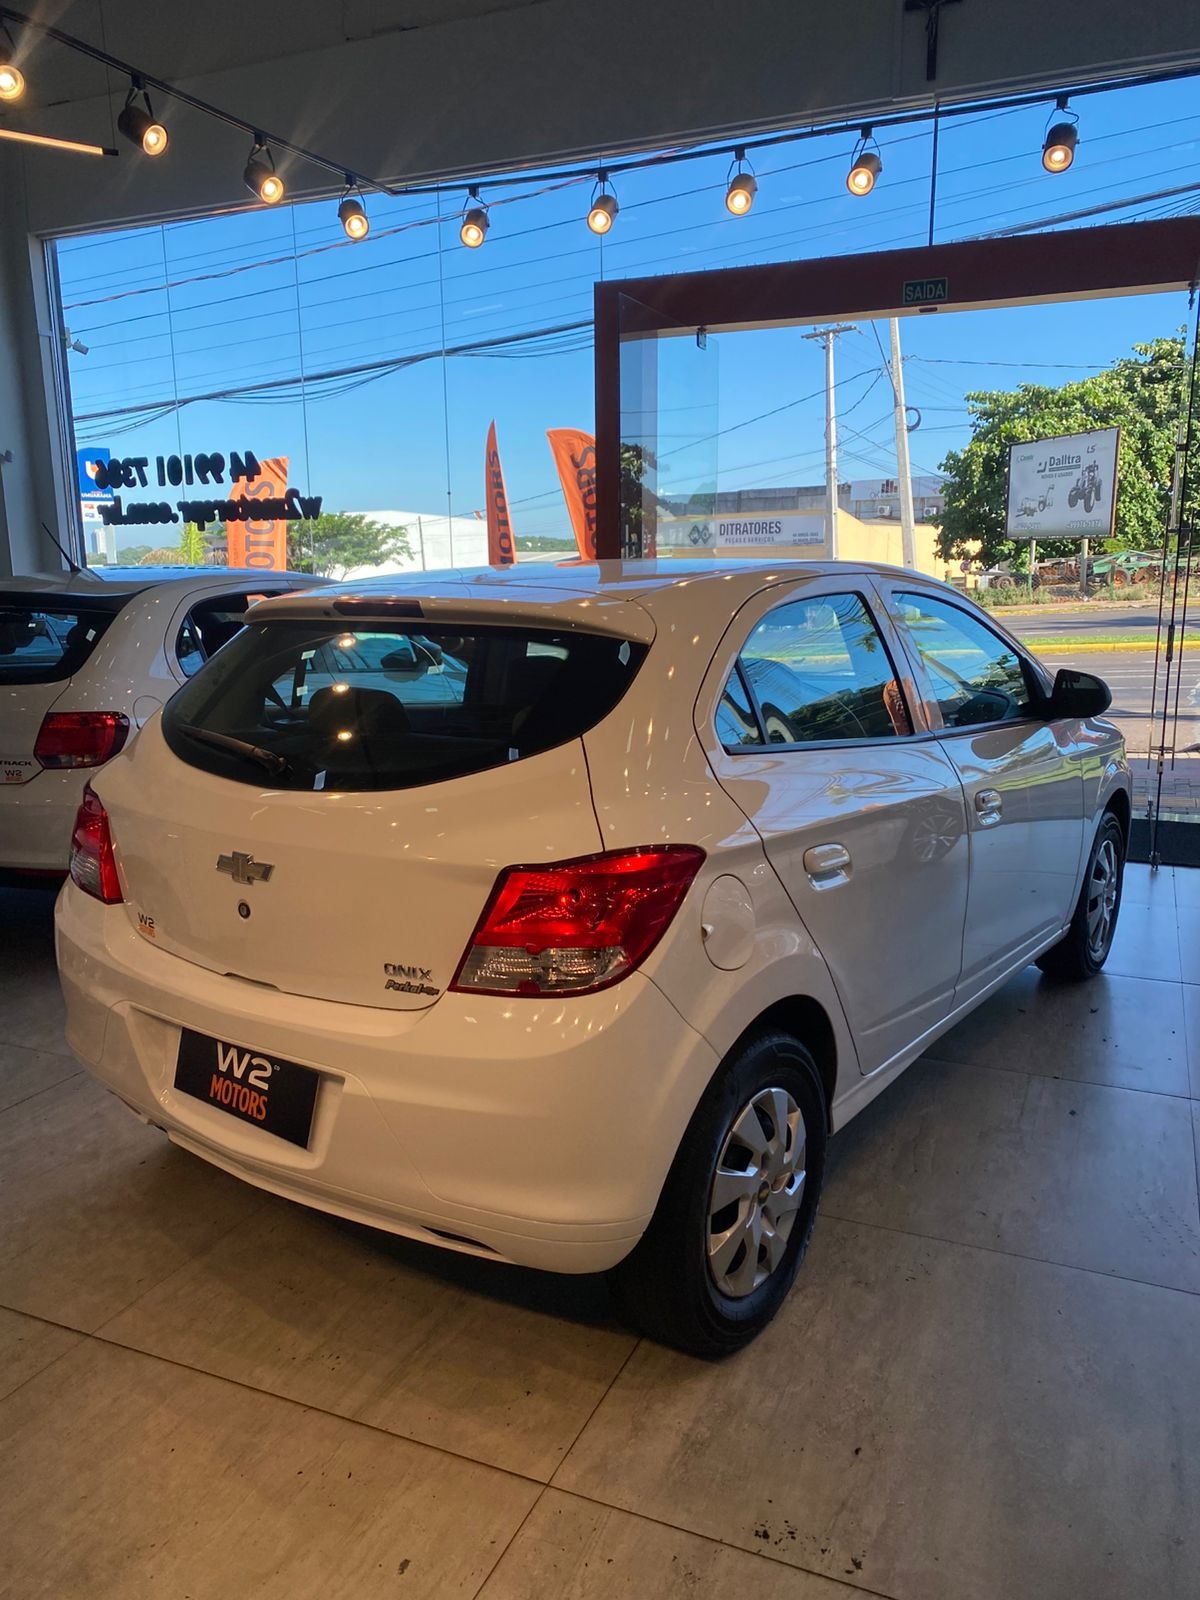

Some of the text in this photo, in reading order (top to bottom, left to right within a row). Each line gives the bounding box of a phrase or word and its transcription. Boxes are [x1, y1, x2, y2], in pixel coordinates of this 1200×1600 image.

[1048, 455, 1081, 467] Dalltra
[719, 521, 782, 536] DITRATORES
[5, 769, 23, 777] W2
[137, 911, 155, 929] W2
[384, 963, 433, 982] ONIX
[217, 1041, 274, 1091] W2
[209, 1074, 268, 1121] MOTORS
